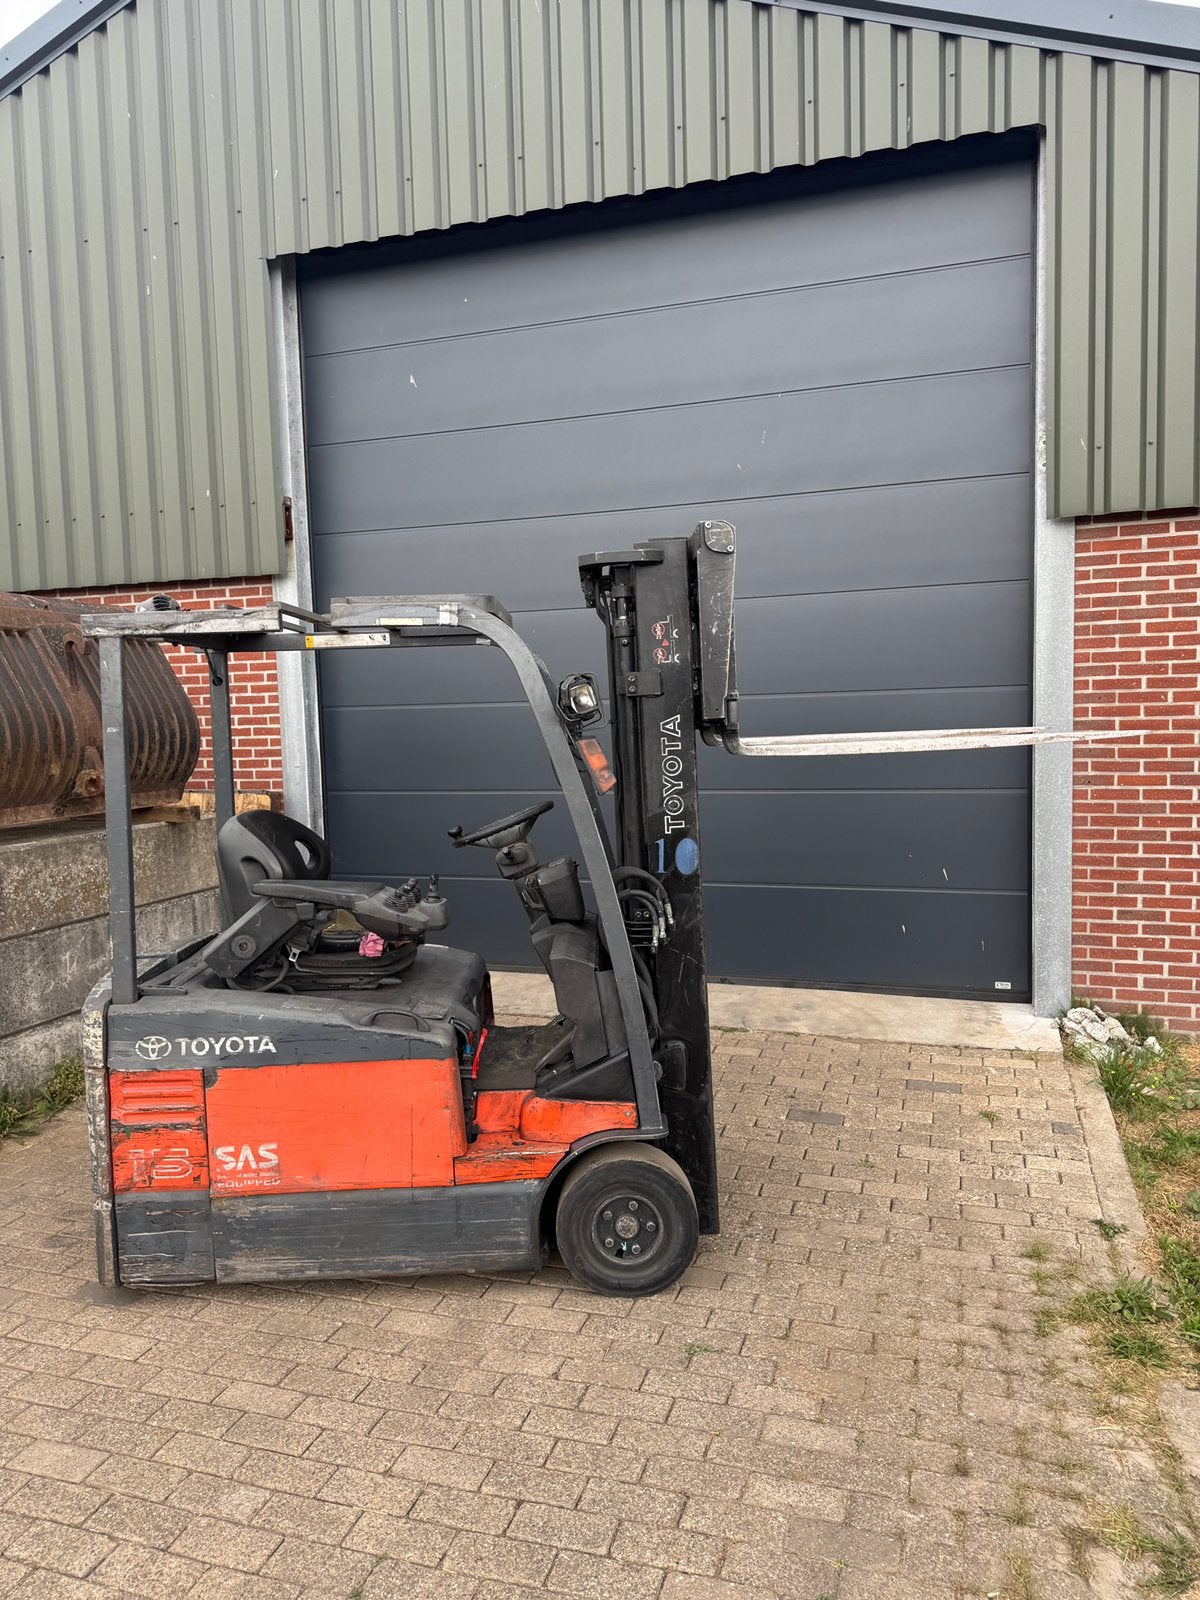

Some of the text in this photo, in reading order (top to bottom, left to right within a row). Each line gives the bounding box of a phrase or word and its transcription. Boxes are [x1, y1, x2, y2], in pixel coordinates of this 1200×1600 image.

[660, 714, 685, 834] TOYOTA
[175, 1035, 277, 1056] TOYOTA
[215, 1142, 279, 1171] SAS
